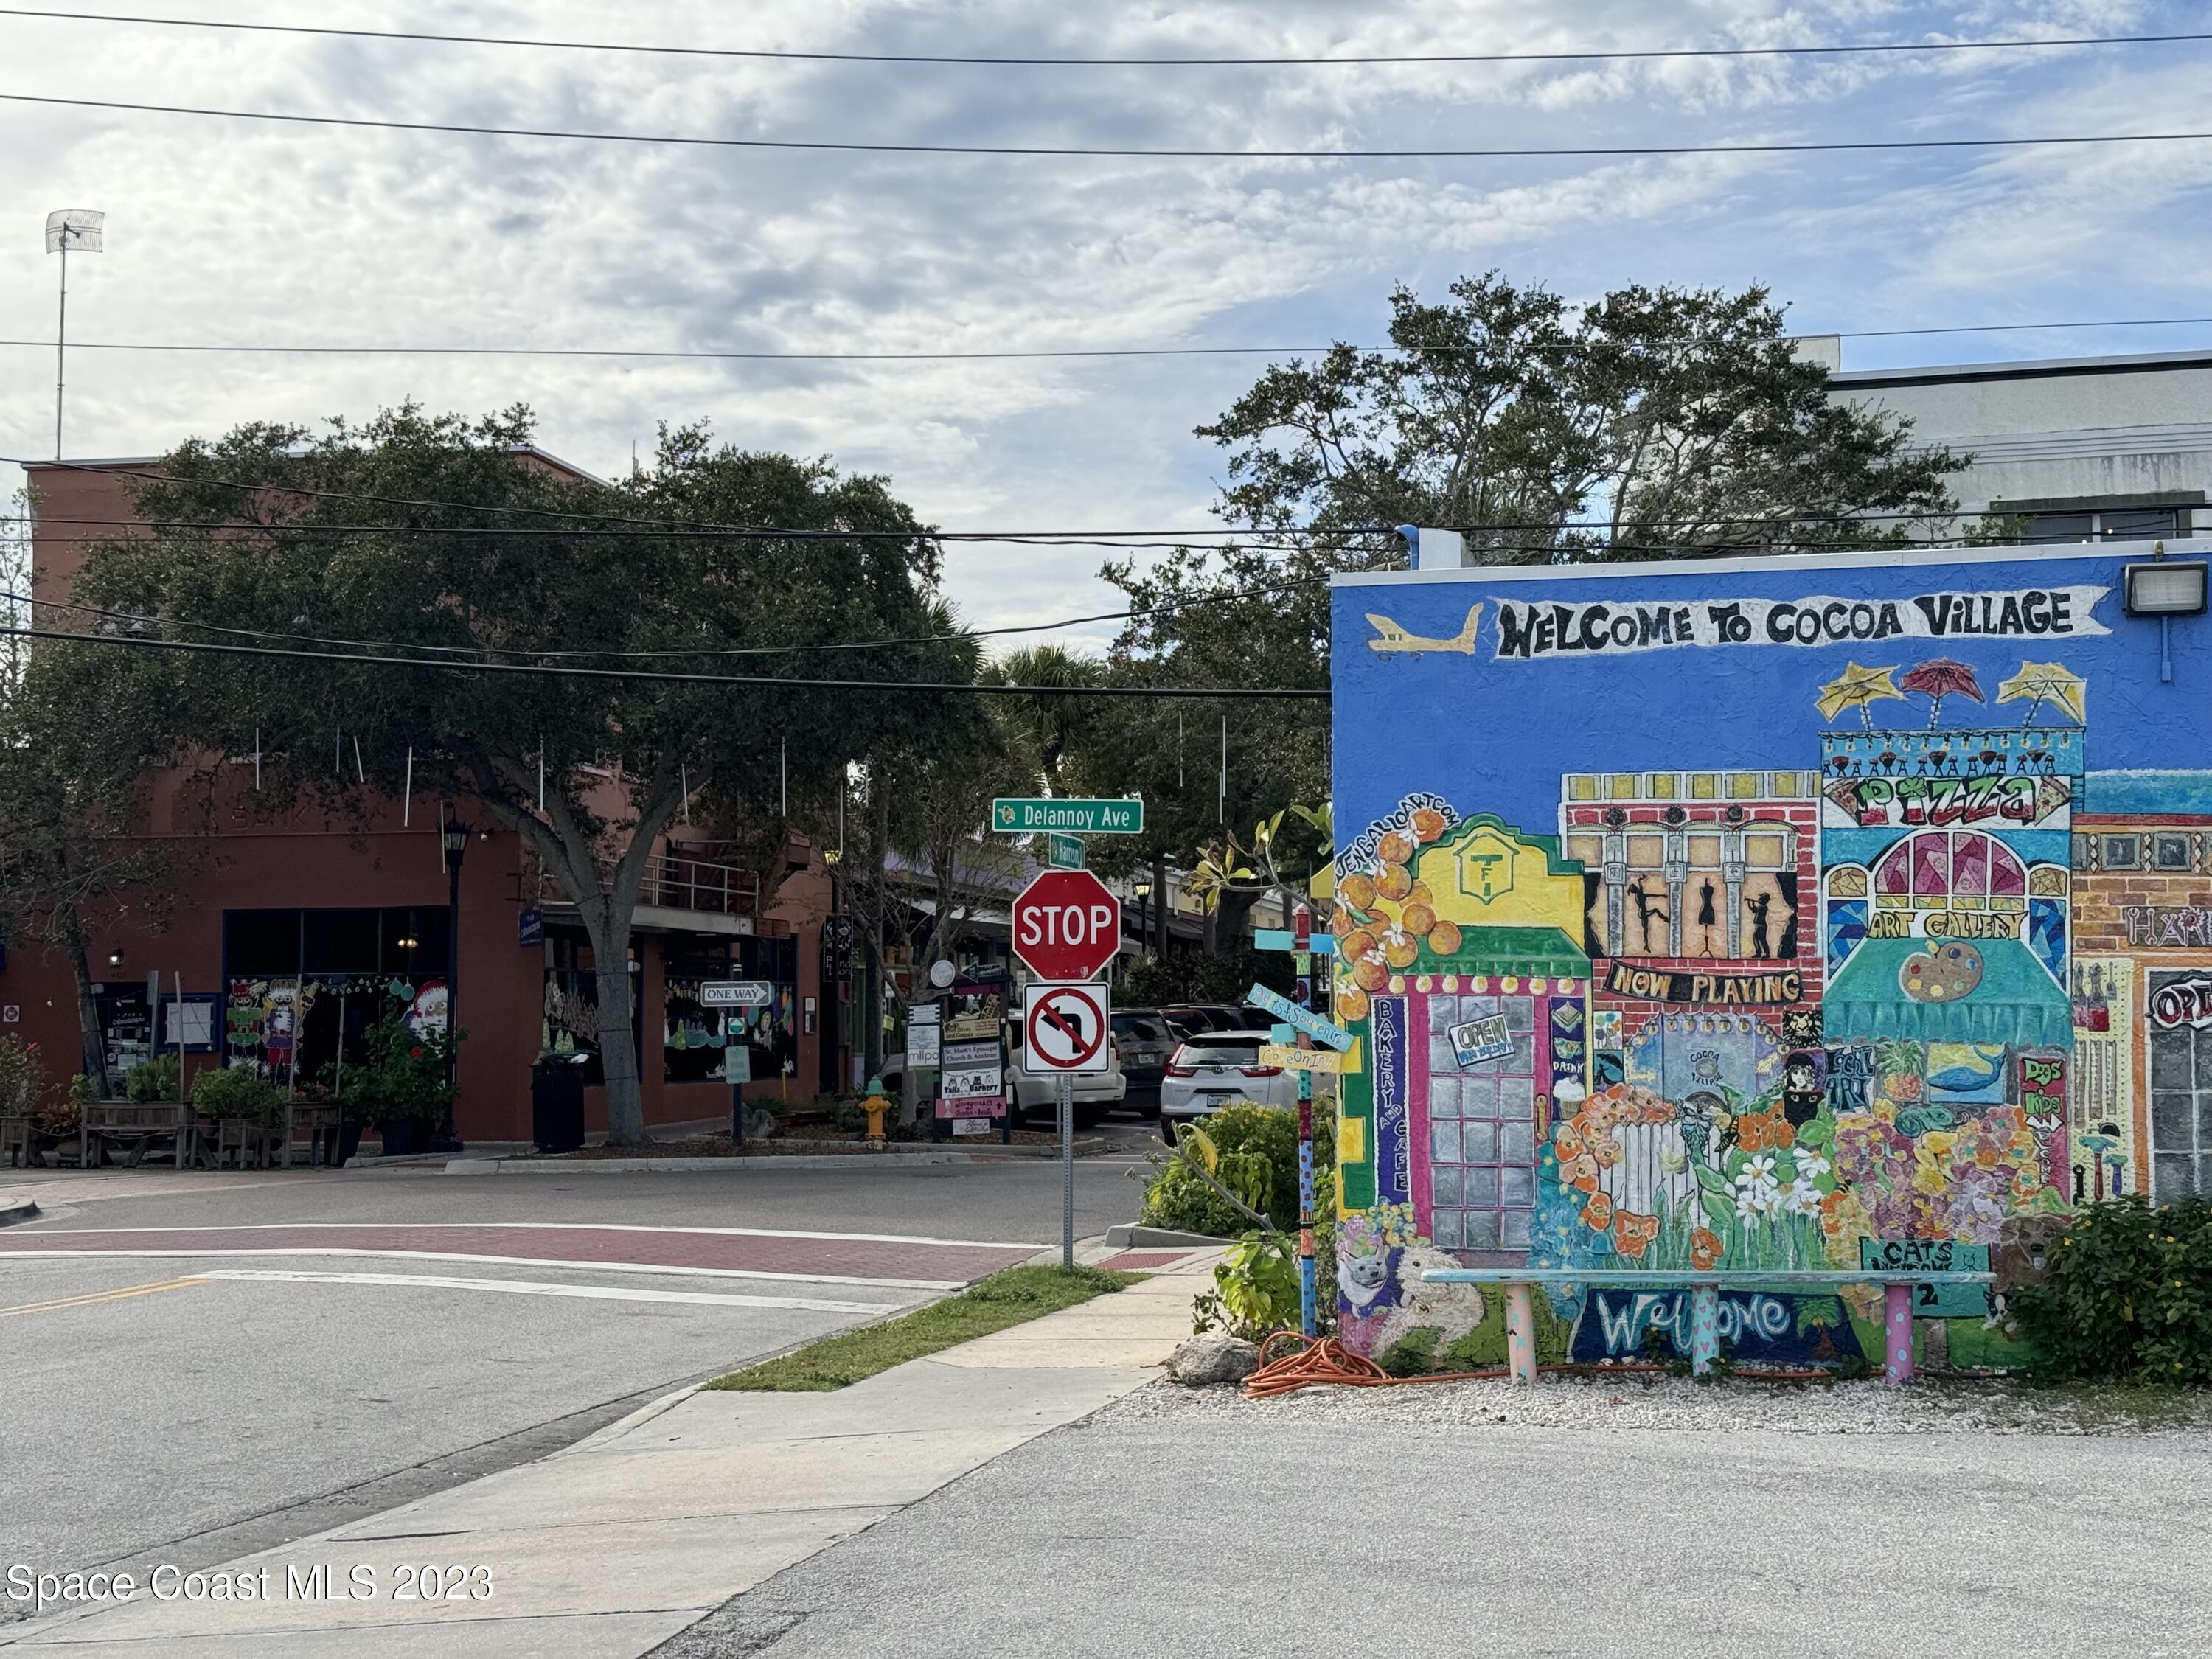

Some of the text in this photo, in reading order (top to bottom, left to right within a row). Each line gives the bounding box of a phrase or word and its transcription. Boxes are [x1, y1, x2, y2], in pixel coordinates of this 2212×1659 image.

[1498, 603, 1694, 658] WELCOME
[1765, 602, 1904, 644] COCOA
[1024, 805, 1130, 830] Delannoy Ave
[1020, 905, 1113, 946] STOP
[1866, 910, 2029, 940] ART GALLERY
[707, 989, 760, 999] ONE WAY
[1613, 964, 1801, 1004] NOW PLAYING
[1457, 1016, 1508, 1049] OPEN
[1377, 999, 1397, 1109] BAKERY
[1552, 1061, 1585, 1074] DRINK
[1689, 1049, 1721, 1063] COCOA
[1380, 1103, 1403, 1130] AND
[1393, 1119, 1409, 1193] CAFE
[1882, 1241, 1953, 1265] CATS
[1916, 1283, 1939, 1307] 2
